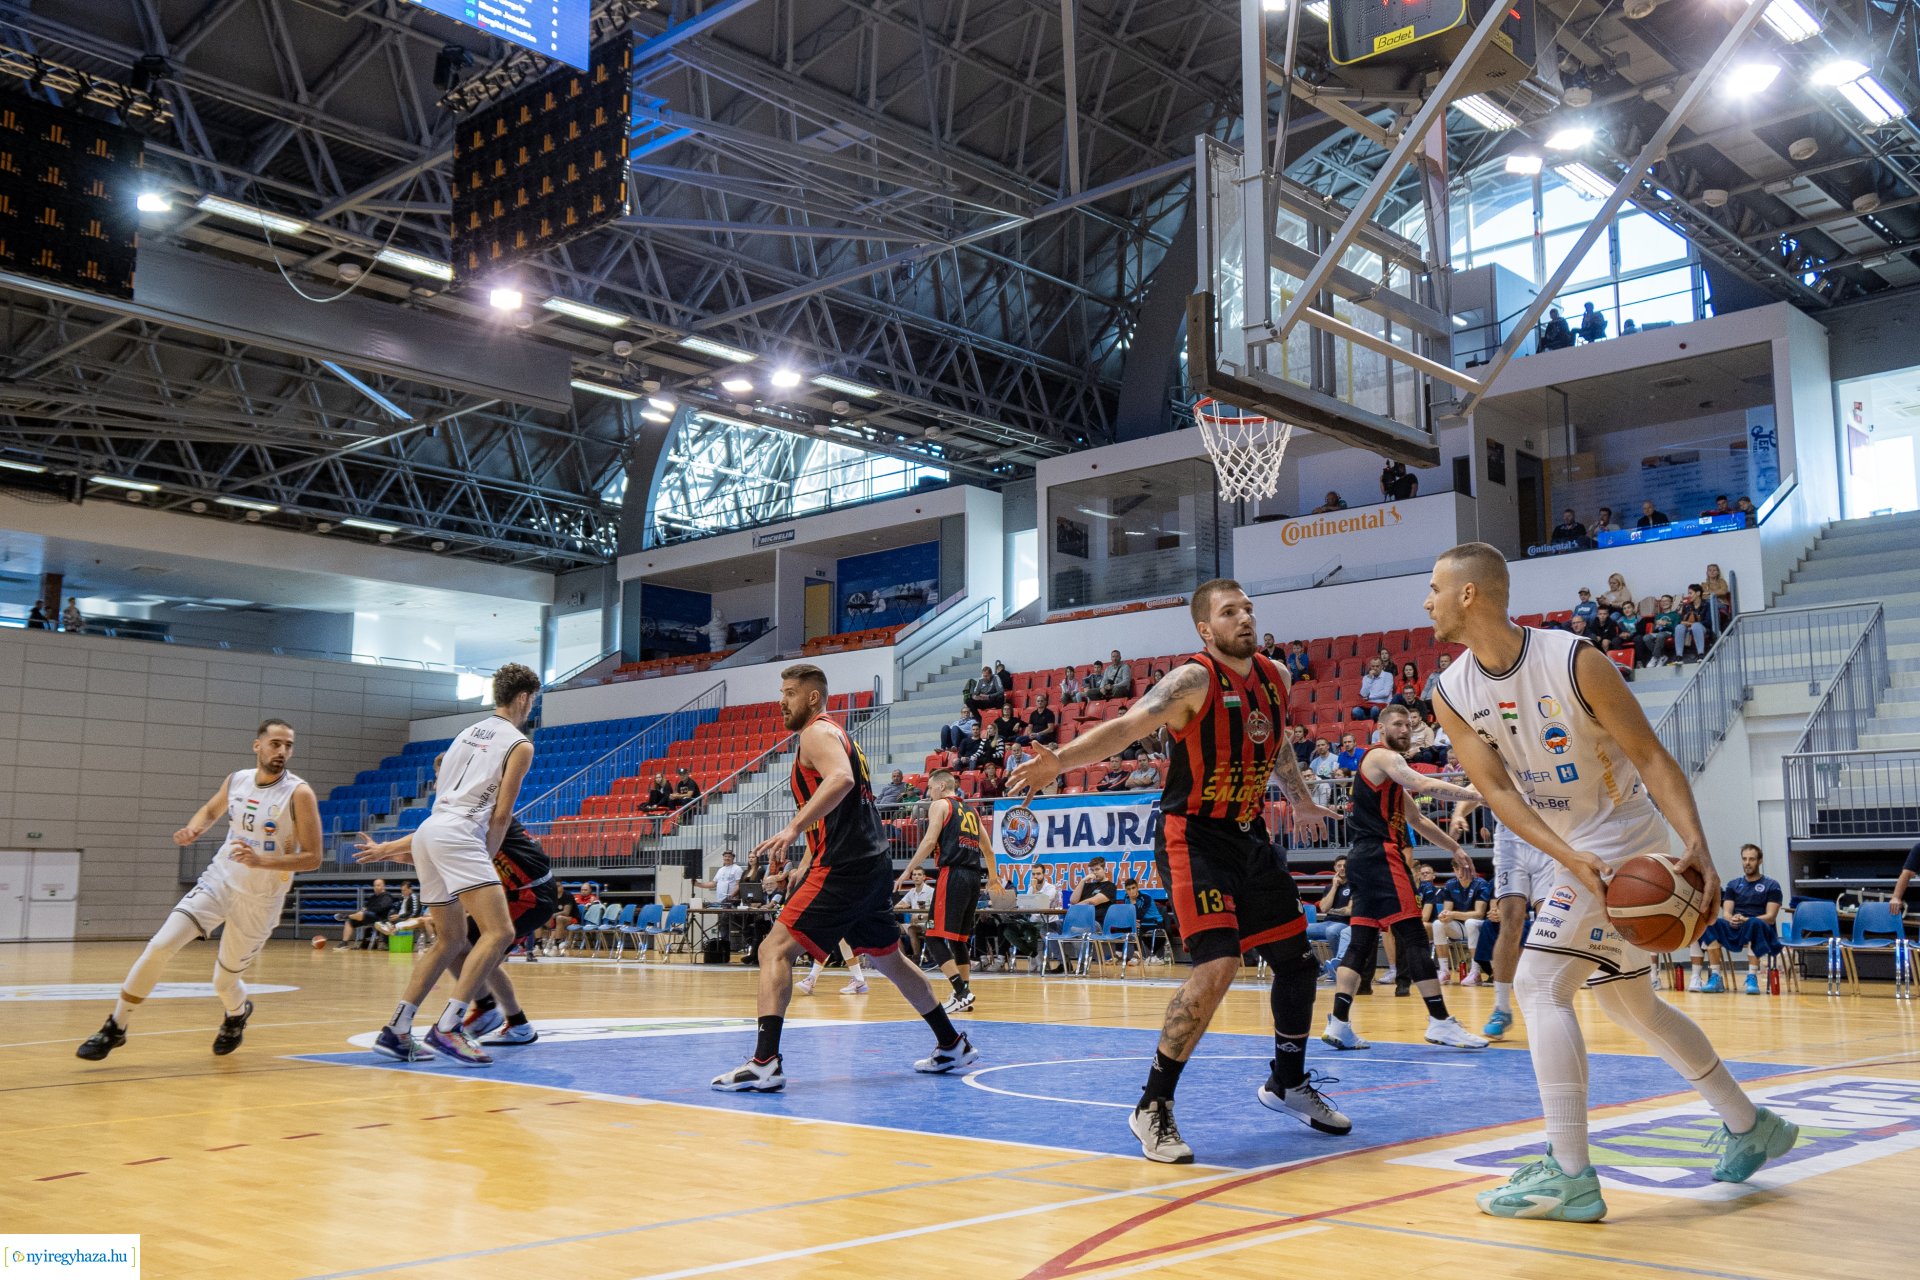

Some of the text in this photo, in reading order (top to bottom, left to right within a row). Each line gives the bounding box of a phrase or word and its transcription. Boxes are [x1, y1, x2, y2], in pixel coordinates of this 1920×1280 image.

[1377, 30, 1412, 49] Bodet
[760, 531, 794, 544] MICHELIN
[1281, 509, 1385, 546] Continental
[1527, 541, 1571, 555] Continental
[1261, 682, 1281, 705] 13
[1472, 708, 1490, 722] AKO
[453, 753, 475, 791] 1
[242, 812, 255, 832] 13
[957, 808, 979, 835] 20
[1198, 889, 1225, 914] 13
[1535, 928, 1557, 939] JAKO
